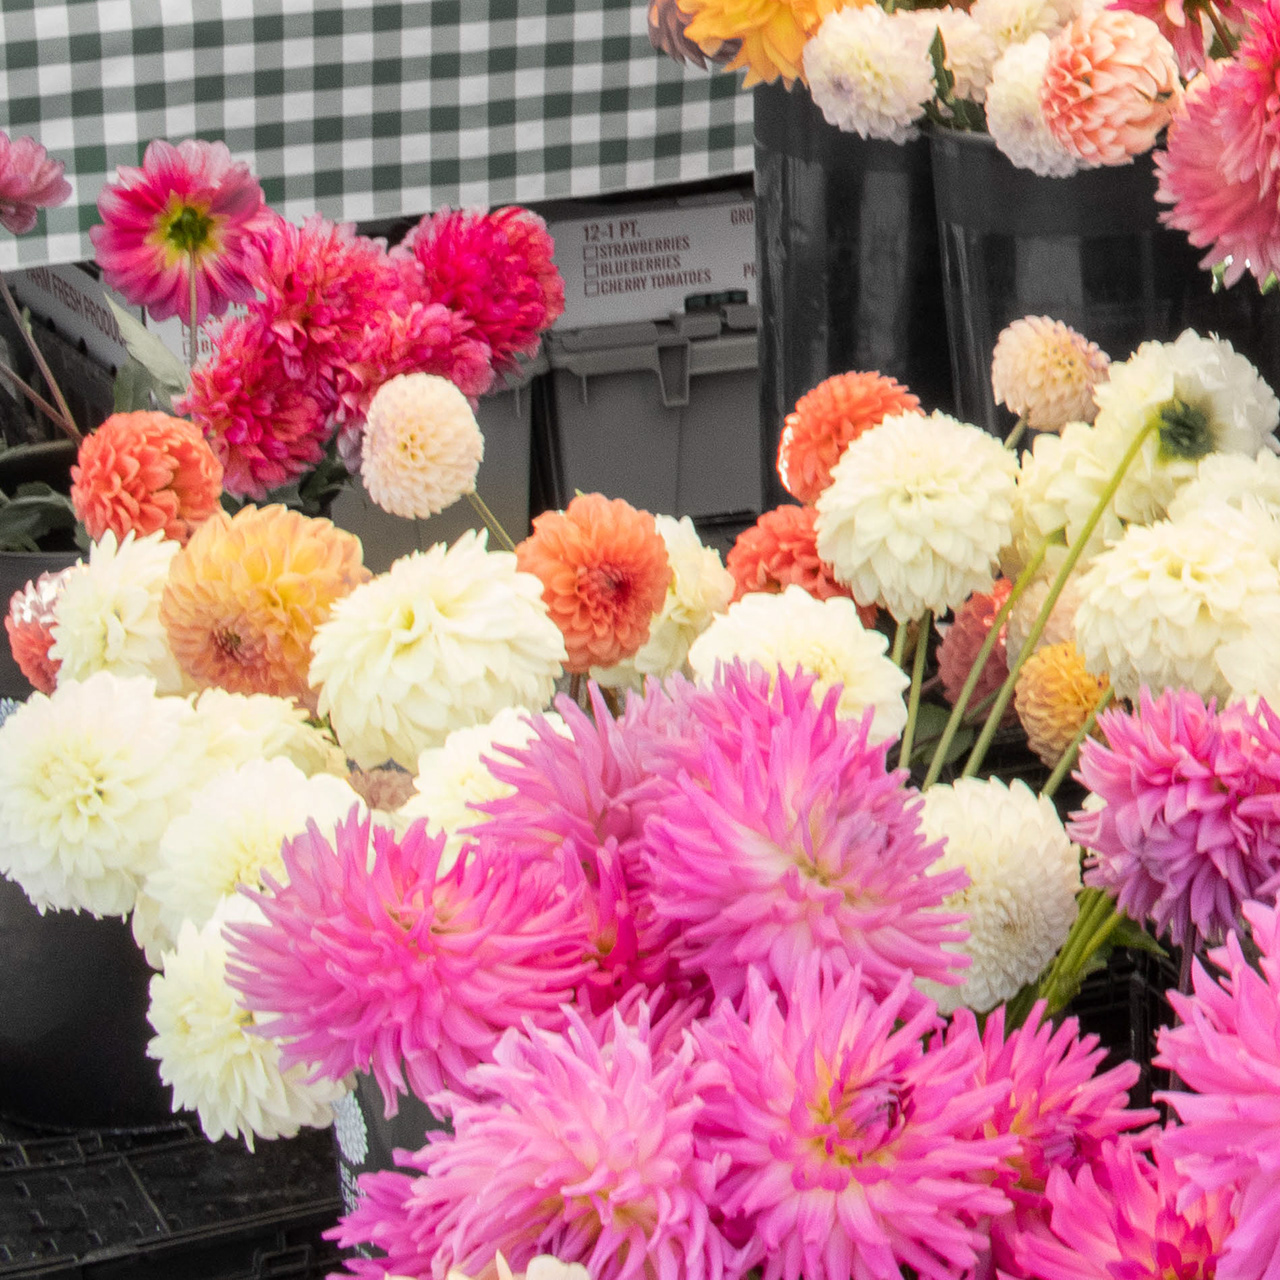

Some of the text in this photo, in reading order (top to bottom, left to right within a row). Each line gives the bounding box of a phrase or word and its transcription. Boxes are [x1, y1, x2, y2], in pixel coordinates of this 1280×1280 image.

[730, 207, 754, 226] GRO
[583, 220, 642, 242] 12-1 PT.
[599, 235, 690, 257] STRAWBERRIES
[600, 255, 681, 276] BLUEBERRIES
[601, 269, 711, 296] CHERRY TOMATOES
